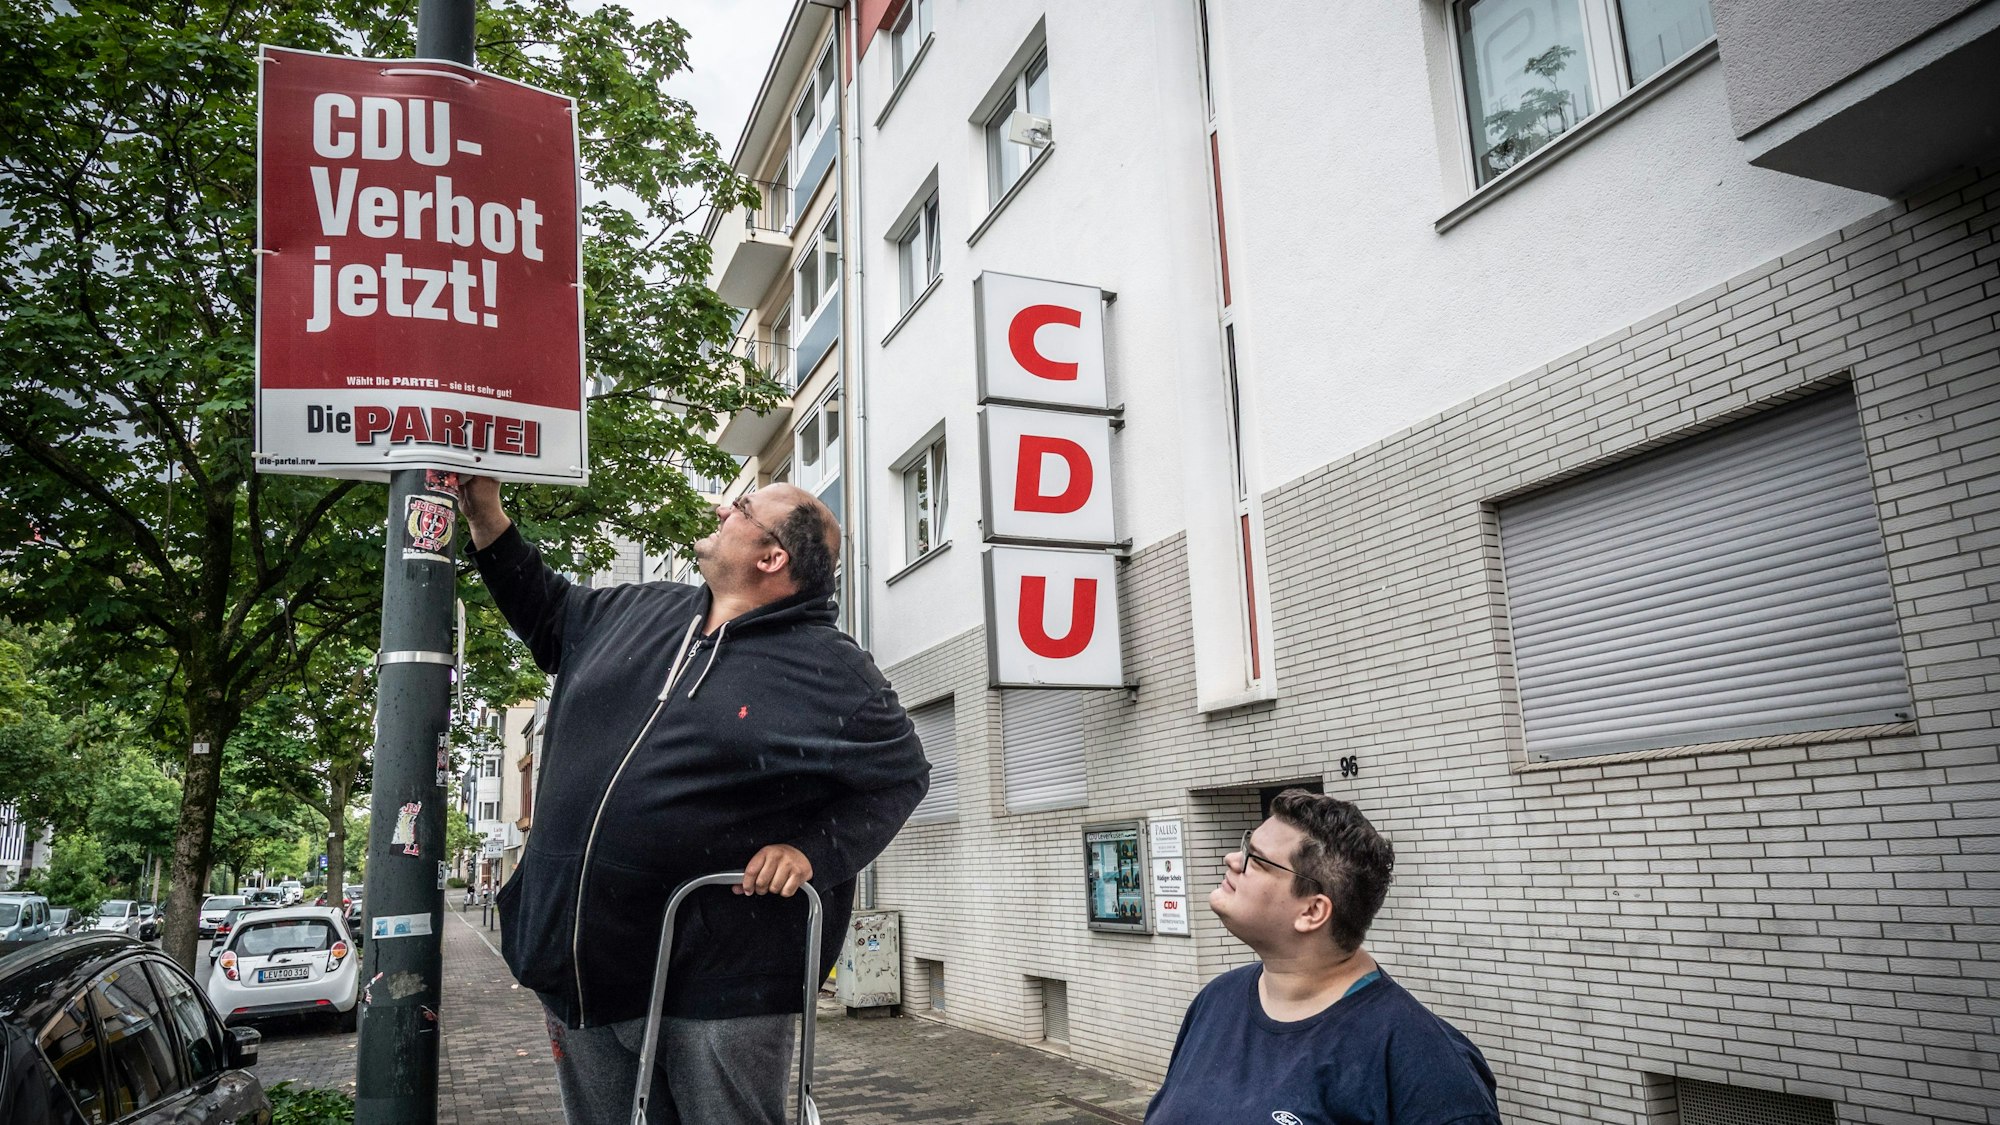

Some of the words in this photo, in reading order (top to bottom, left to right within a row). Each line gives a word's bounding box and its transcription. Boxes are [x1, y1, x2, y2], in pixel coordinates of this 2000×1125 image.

[313, 92, 483, 167] CDU-
[309, 165, 543, 262] Verbot
[306, 245, 498, 333] jetzt!
[346, 376, 374, 386] Wählt
[376, 376, 390, 386] Die
[392, 376, 439, 388] PARTEI
[449, 380, 462, 391] sie
[464, 380, 476, 392] ist
[477, 382, 495, 395] sehr
[496, 388, 512, 398] gut!
[307, 404, 351, 434] Die
[354, 405, 540, 457] PARTEI
[259, 456, 317, 466] die-partei.nrw
[1340, 755, 1359, 778] 96
[1164, 901, 1178, 910] CDU
[264, 970, 279, 979] LEV
[294, 968, 308, 976] 316
